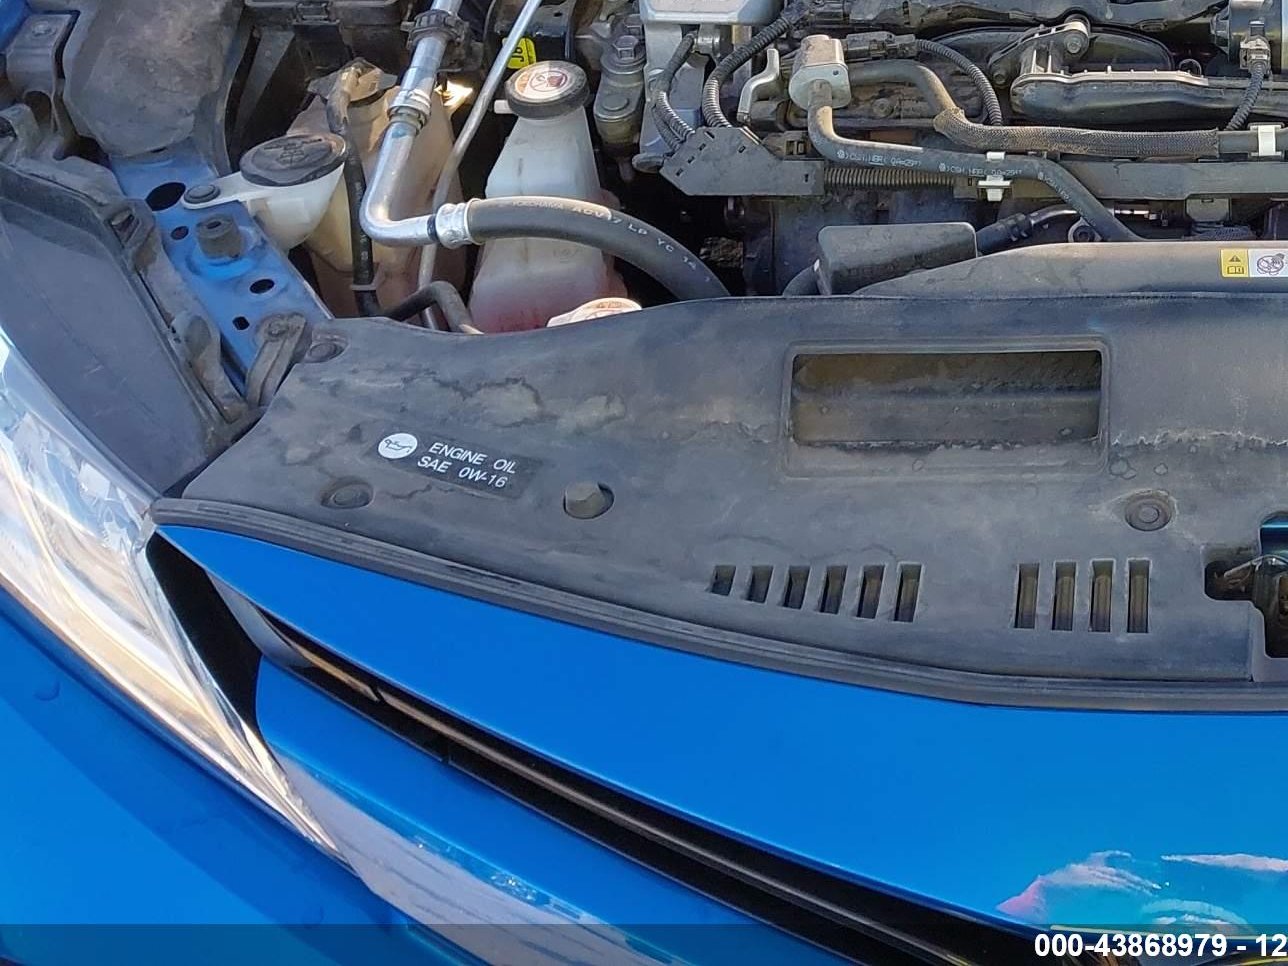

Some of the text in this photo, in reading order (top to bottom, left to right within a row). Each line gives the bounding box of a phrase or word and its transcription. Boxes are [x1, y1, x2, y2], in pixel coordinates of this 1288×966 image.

[417, 456, 508, 488] SAE 0W-16
[428, 442, 517, 474] ENGINE OIL
